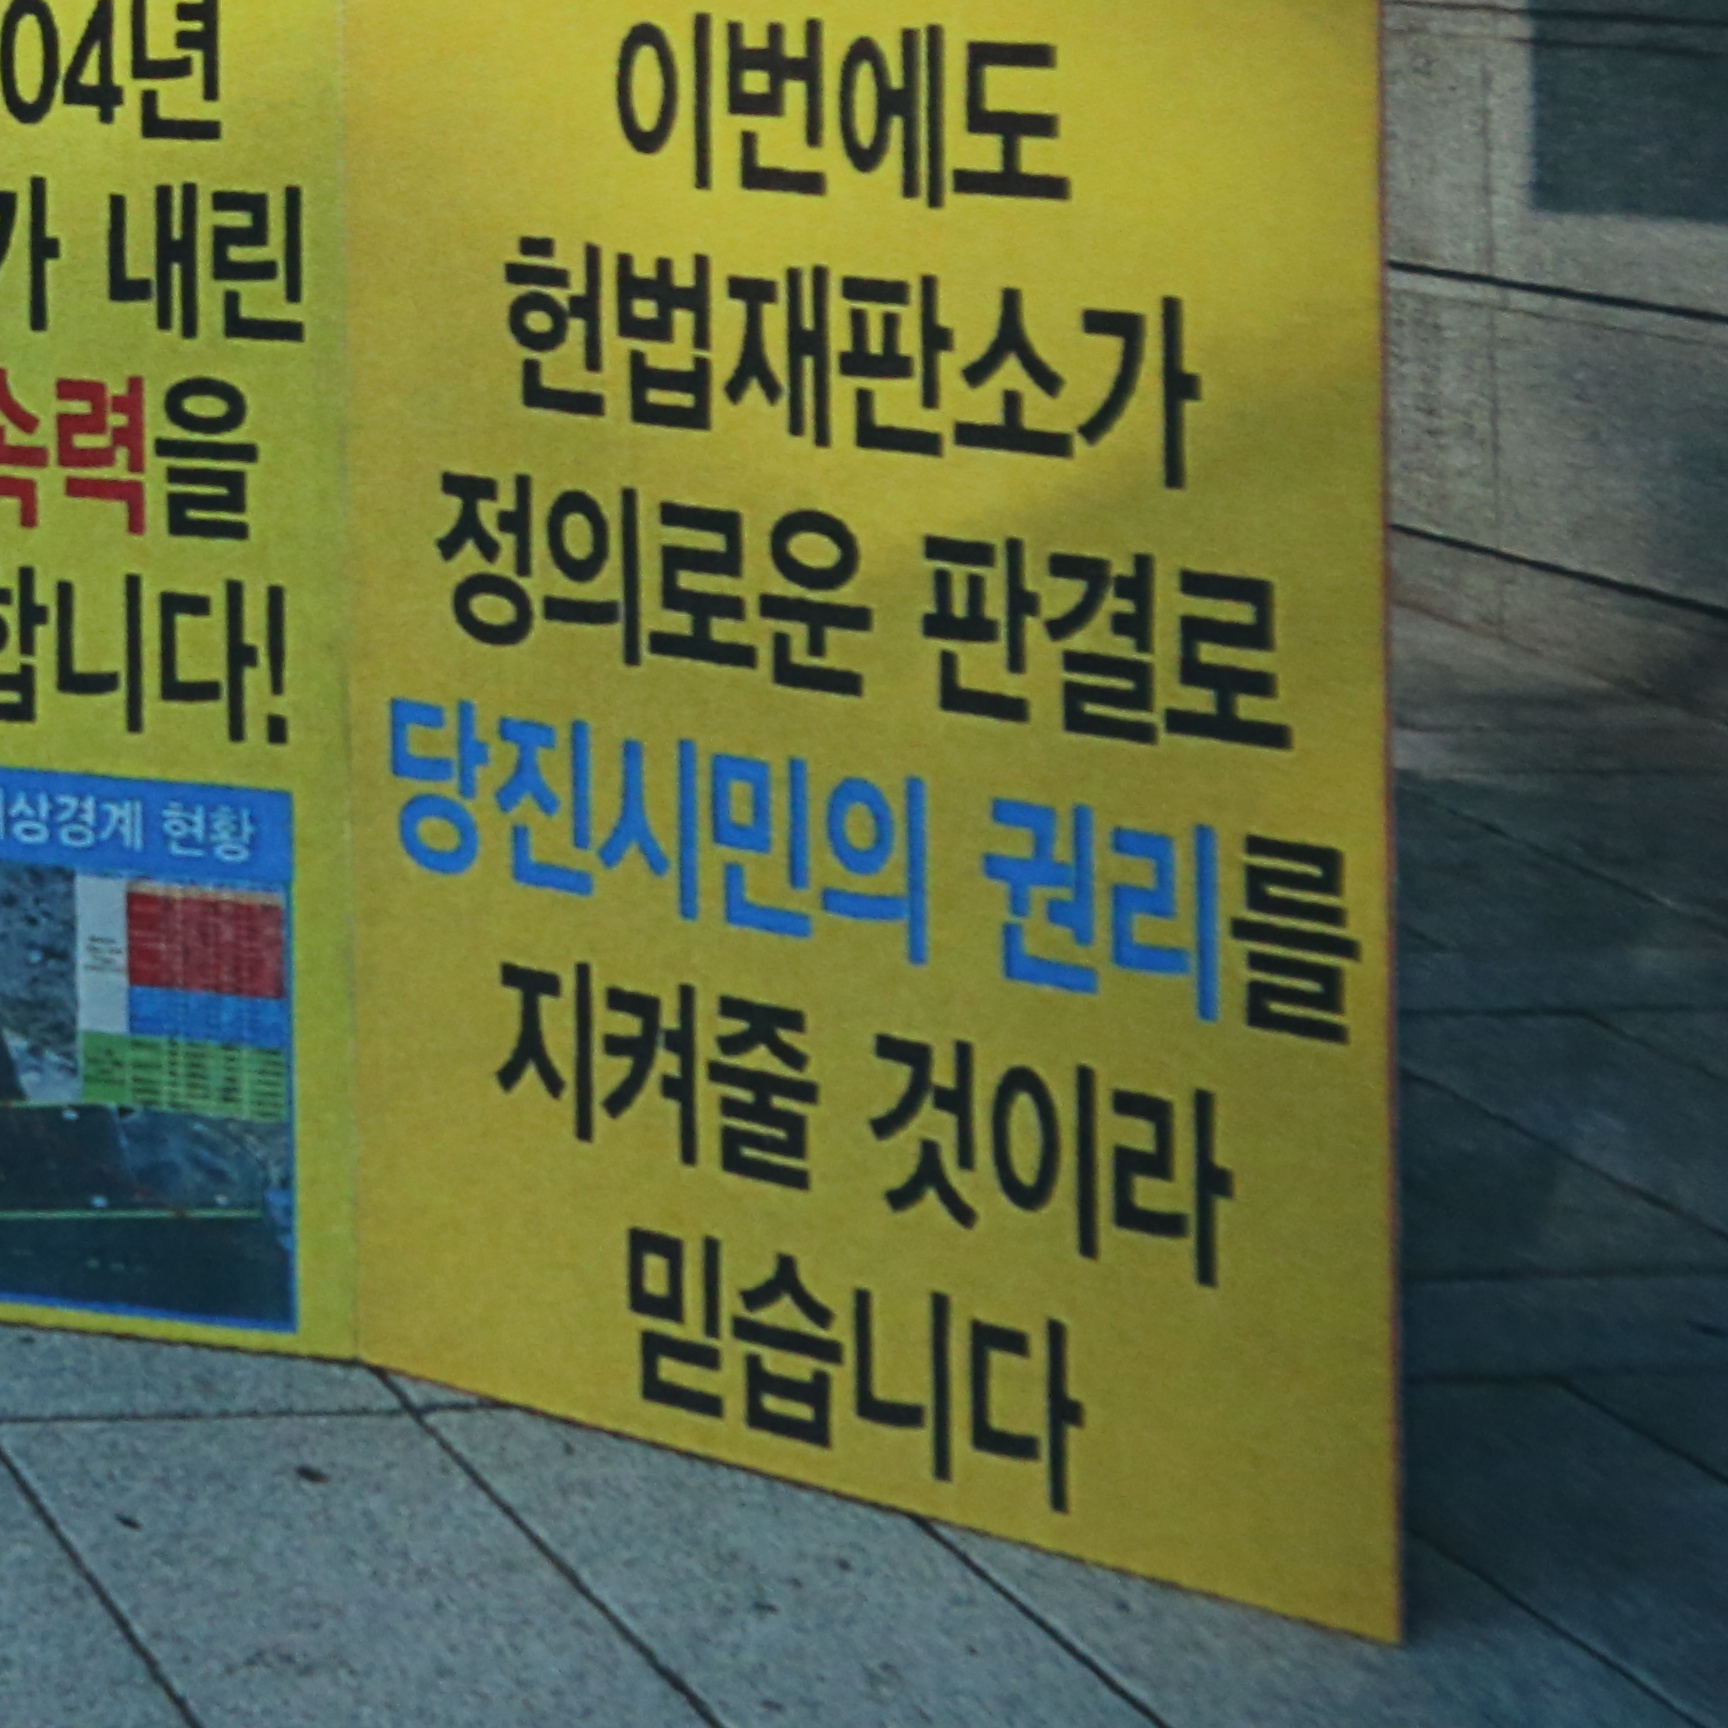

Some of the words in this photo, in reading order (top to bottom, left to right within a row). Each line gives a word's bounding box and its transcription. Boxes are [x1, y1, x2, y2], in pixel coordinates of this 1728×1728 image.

[617, 13, 1071, 209] 이번에도
[108, 182, 305, 342] 내린
[503, 237, 1202, 489] 헌법재판소가
[437, 472, 873, 697] 정의로운
[922, 535, 1292, 750] 판결로
[161, 801, 257, 863] 현황
[389, 697, 928, 966] 당진시민의
[981, 797, 1361, 1045] 권리를
[496, 962, 819, 1191] 지켜줄
[869, 1033, 1234, 1289] 것이라
[627, 1225, 1084, 1513] 믿습니다
